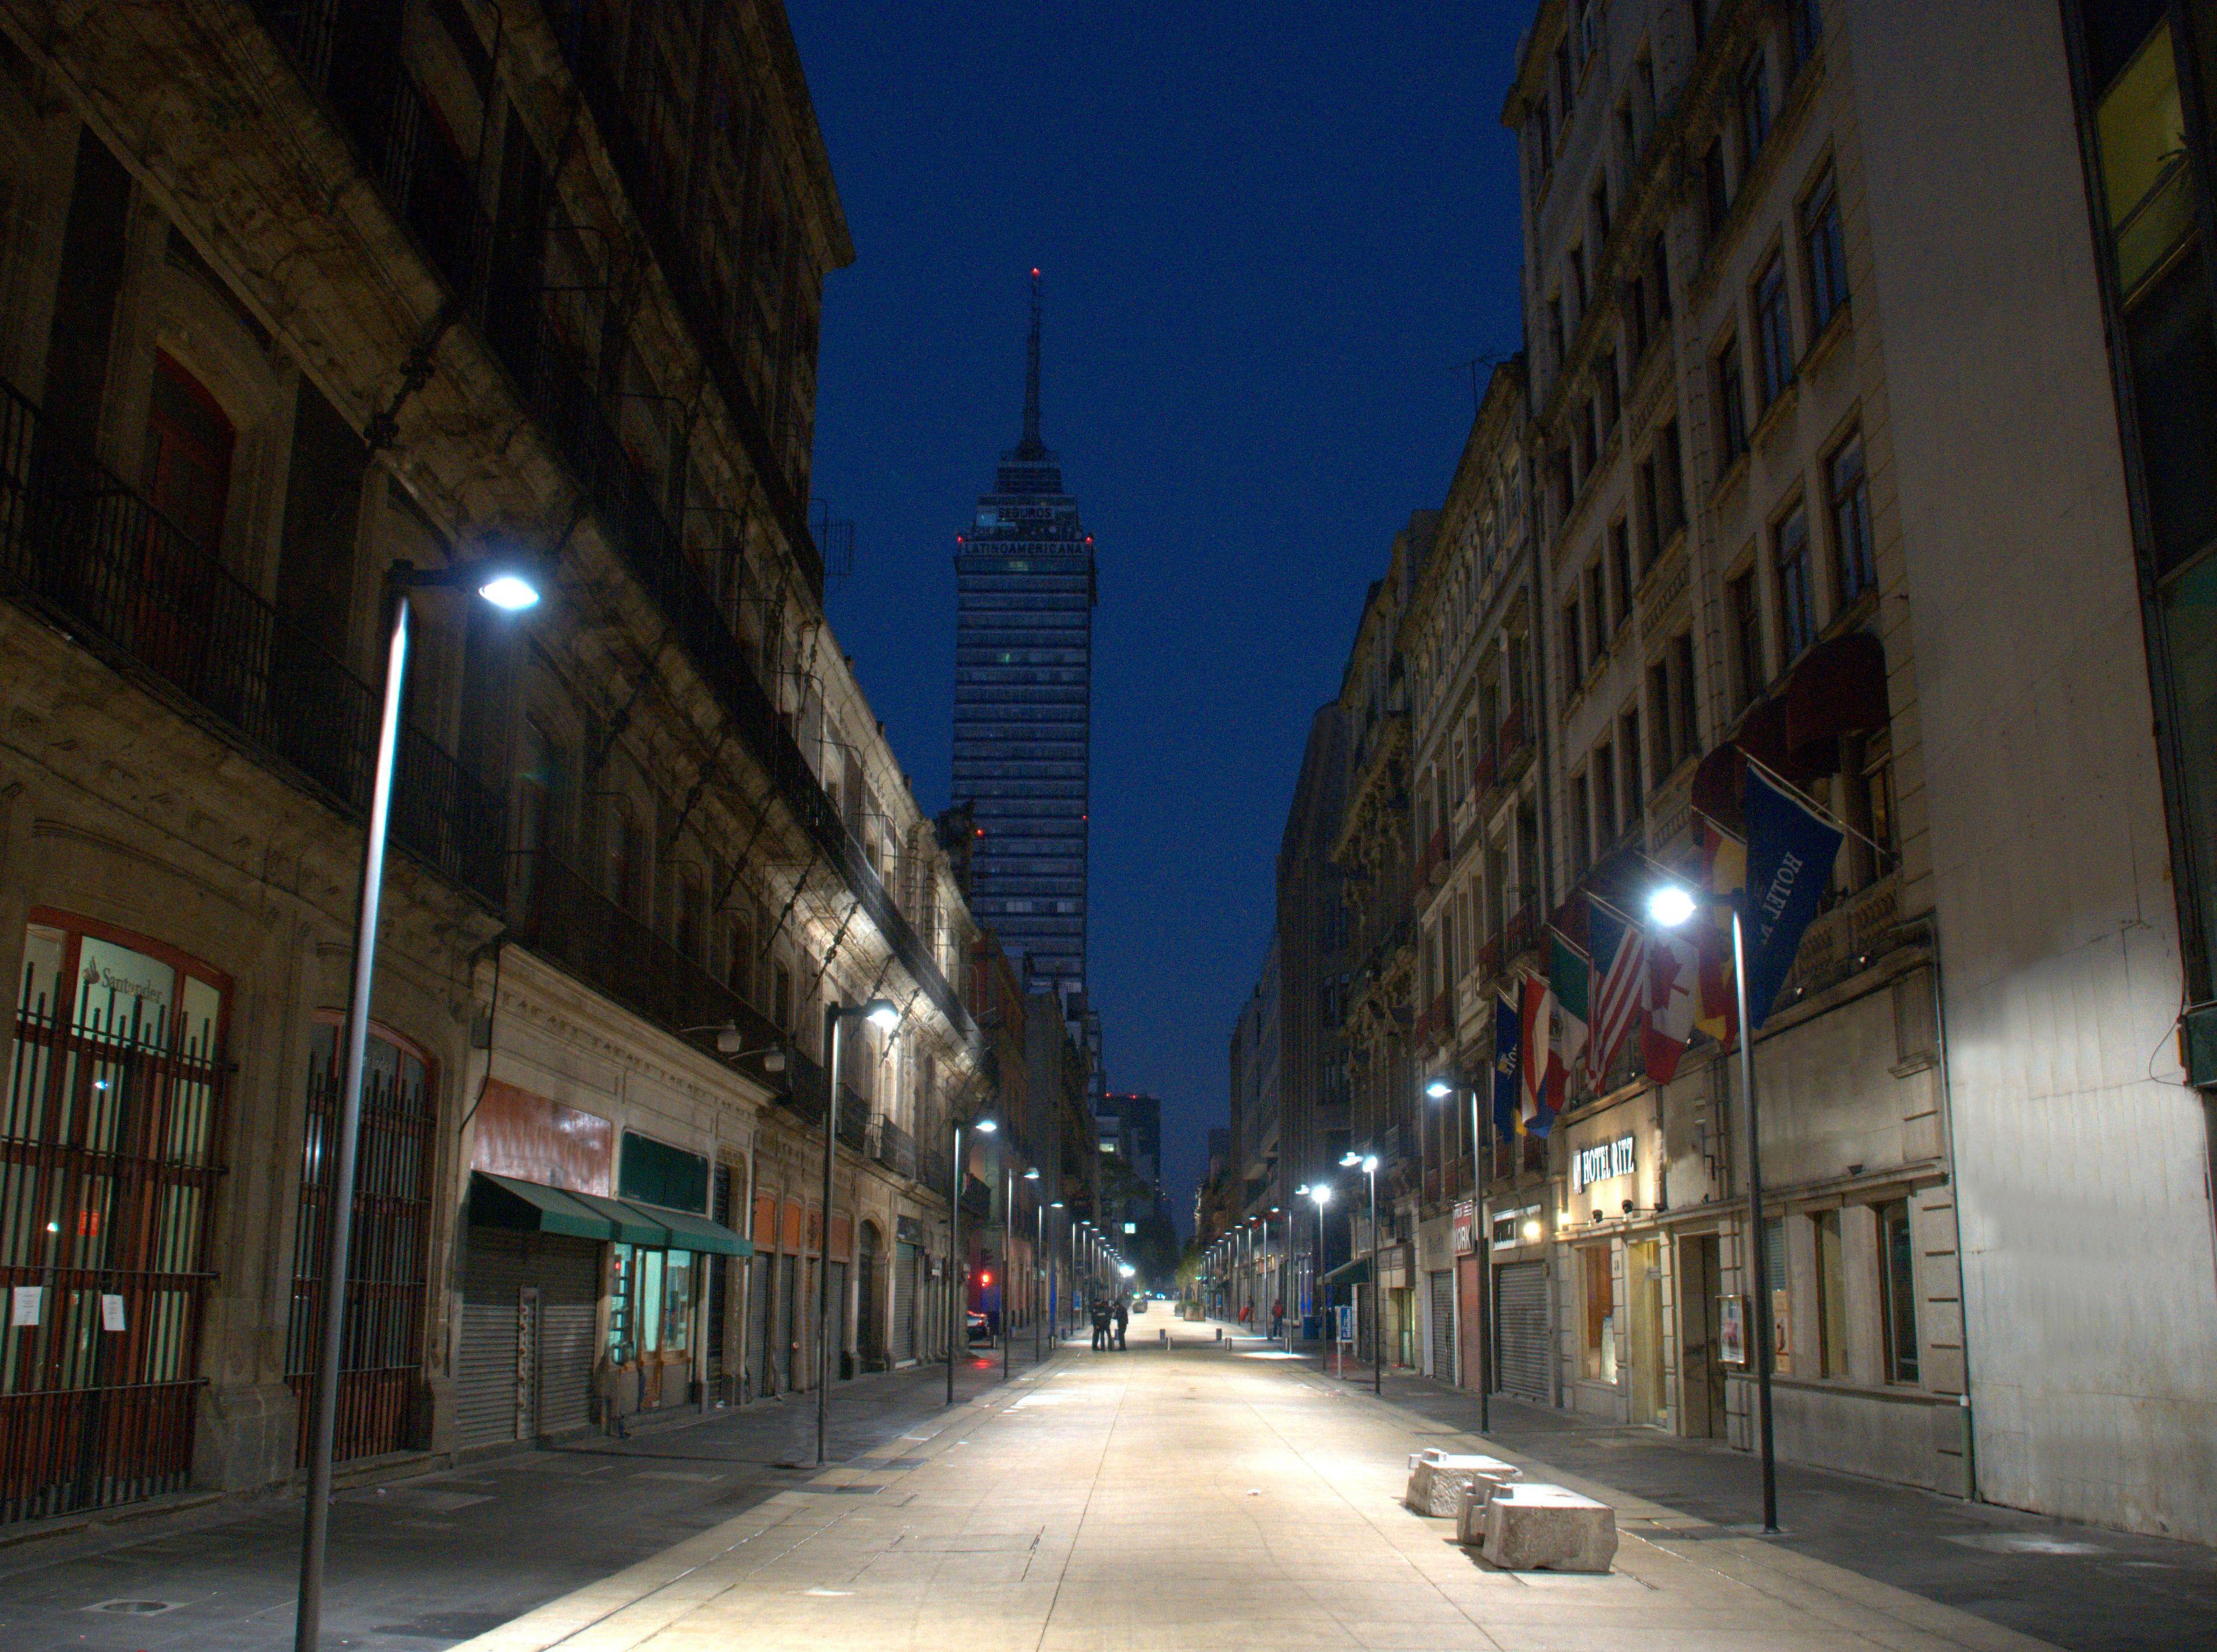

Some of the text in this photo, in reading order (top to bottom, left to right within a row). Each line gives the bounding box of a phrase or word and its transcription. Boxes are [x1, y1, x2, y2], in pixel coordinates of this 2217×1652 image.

[998, 507, 1052, 518] SEGUROS
[965, 543, 1082, 554] LATINOAMERICANA
[101, 967, 163, 1004] Santander
[1582, 1136, 1634, 1185] HOTEL RITZ
